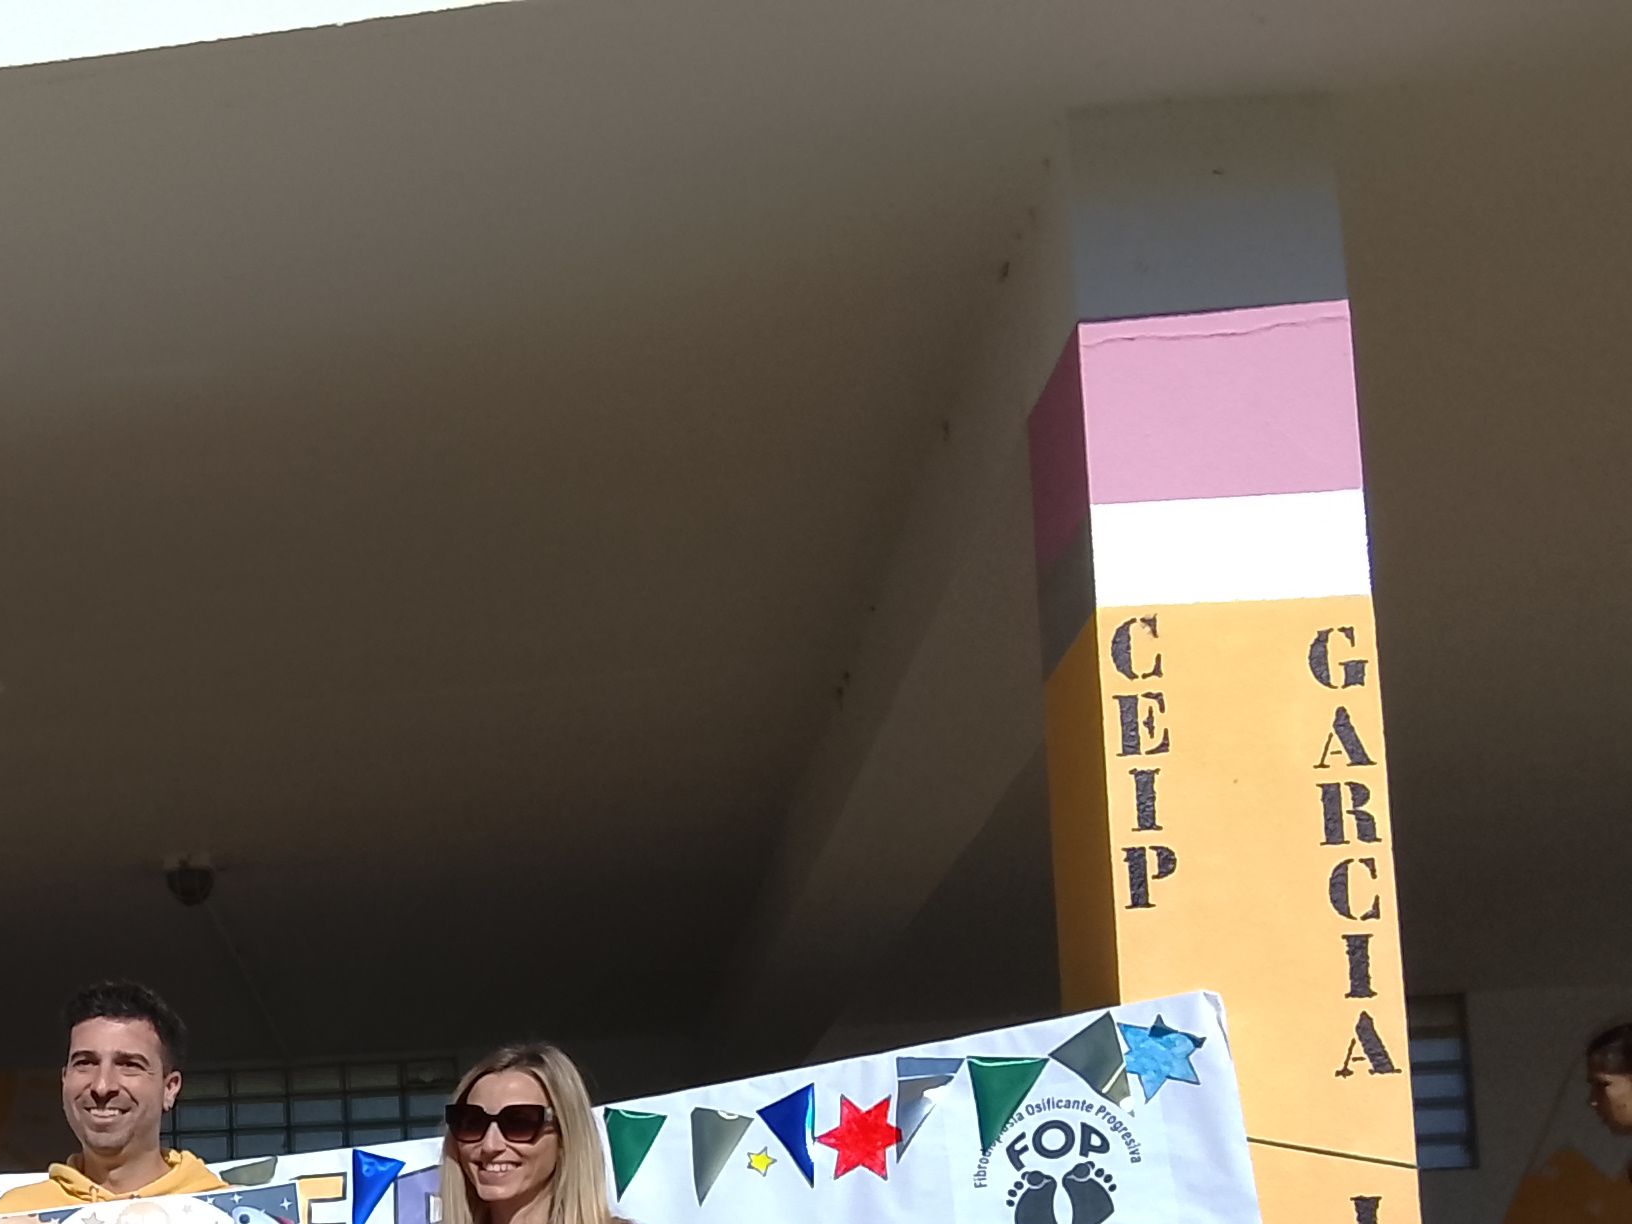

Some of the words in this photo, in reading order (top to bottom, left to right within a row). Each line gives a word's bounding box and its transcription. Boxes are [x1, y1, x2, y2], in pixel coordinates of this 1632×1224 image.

[1110, 613, 1177, 909] CEIP
[1307, 626, 1402, 1078] GARCIA
[1006, 1119, 1110, 1172] FOP
[1025, 1096, 1094, 1116] Osificante
[1094, 1104, 1142, 1163] Progresiva
